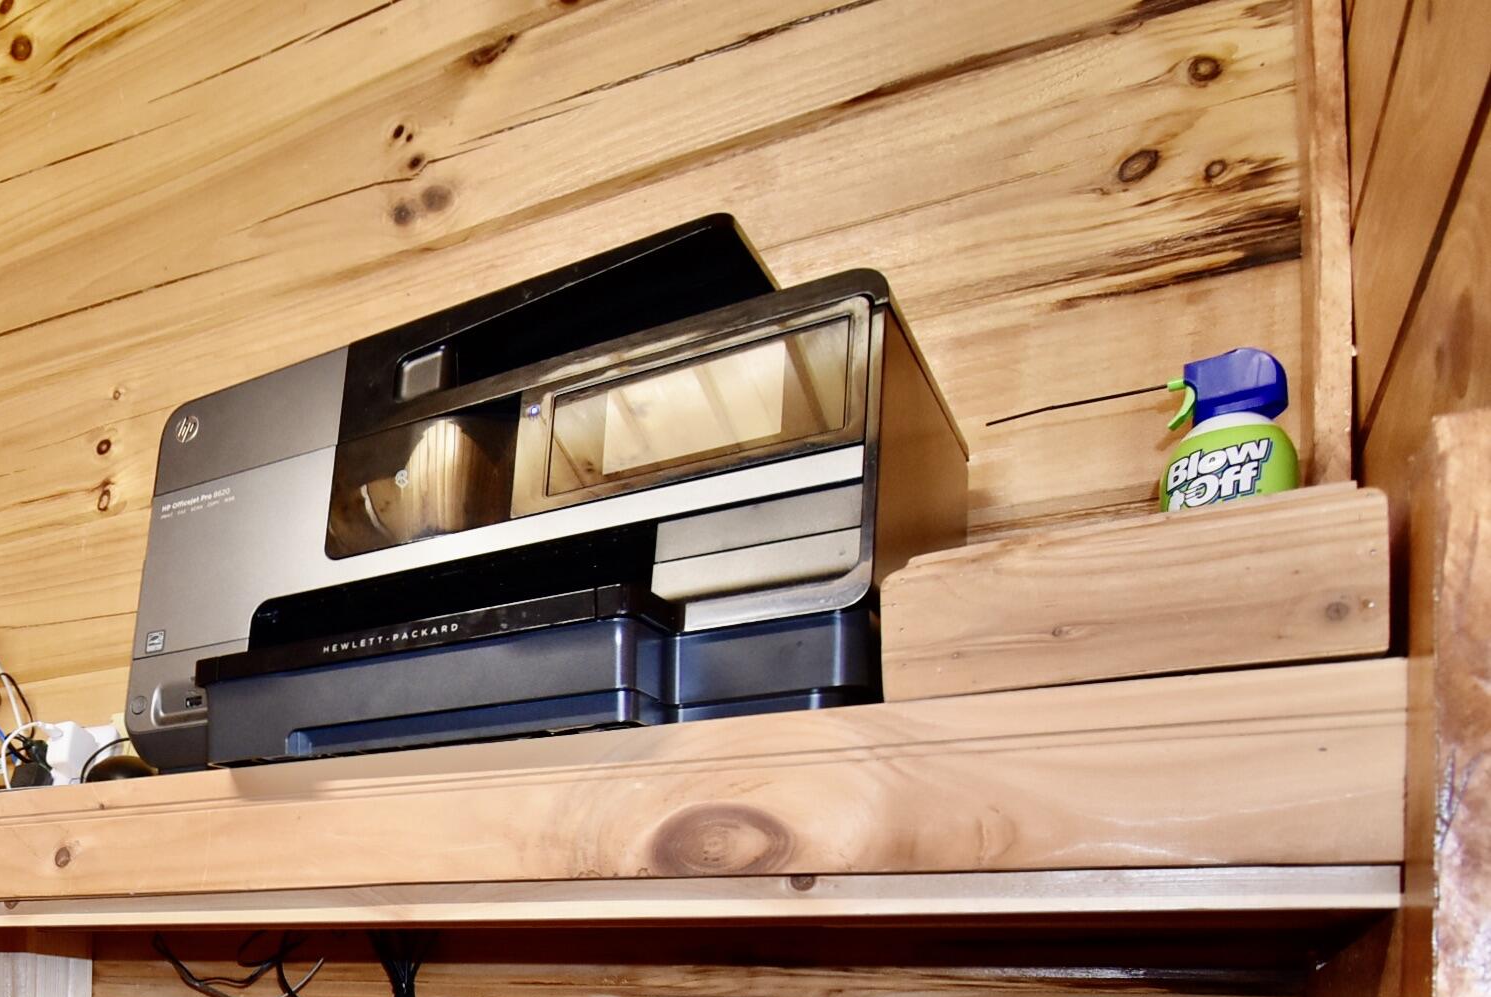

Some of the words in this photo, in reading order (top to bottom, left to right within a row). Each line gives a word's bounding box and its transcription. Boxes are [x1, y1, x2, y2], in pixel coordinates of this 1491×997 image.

[1166, 438, 1272, 494] Blow
[1184, 461, 1261, 508] Off
[161, 504, 171, 512] HP
[200, 493, 212, 501] Pro
[322, 623, 459, 653] HEWLETT-PACKARD
